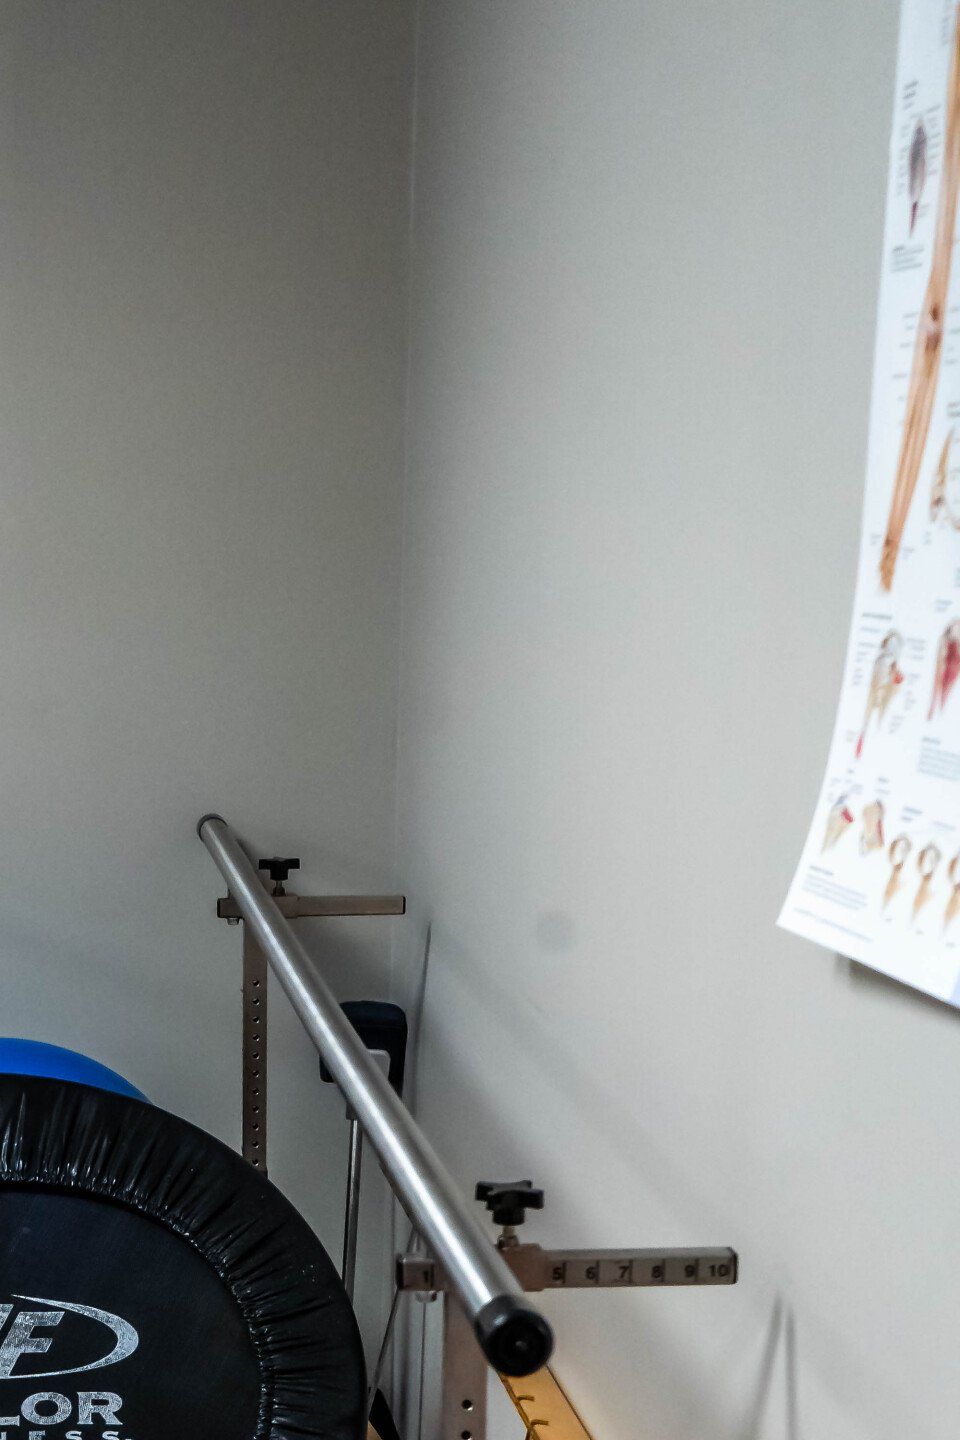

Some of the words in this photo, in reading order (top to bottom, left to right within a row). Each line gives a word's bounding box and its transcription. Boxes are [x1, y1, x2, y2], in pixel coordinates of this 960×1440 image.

[552, 1266, 563, 1282] 5
[585, 1265, 596, 1281] 6
[618, 1265, 630, 1280] 7
[651, 1265, 662, 1280] 8
[684, 1264, 696, 1279] 9
[709, 1263, 730, 1278] 10
